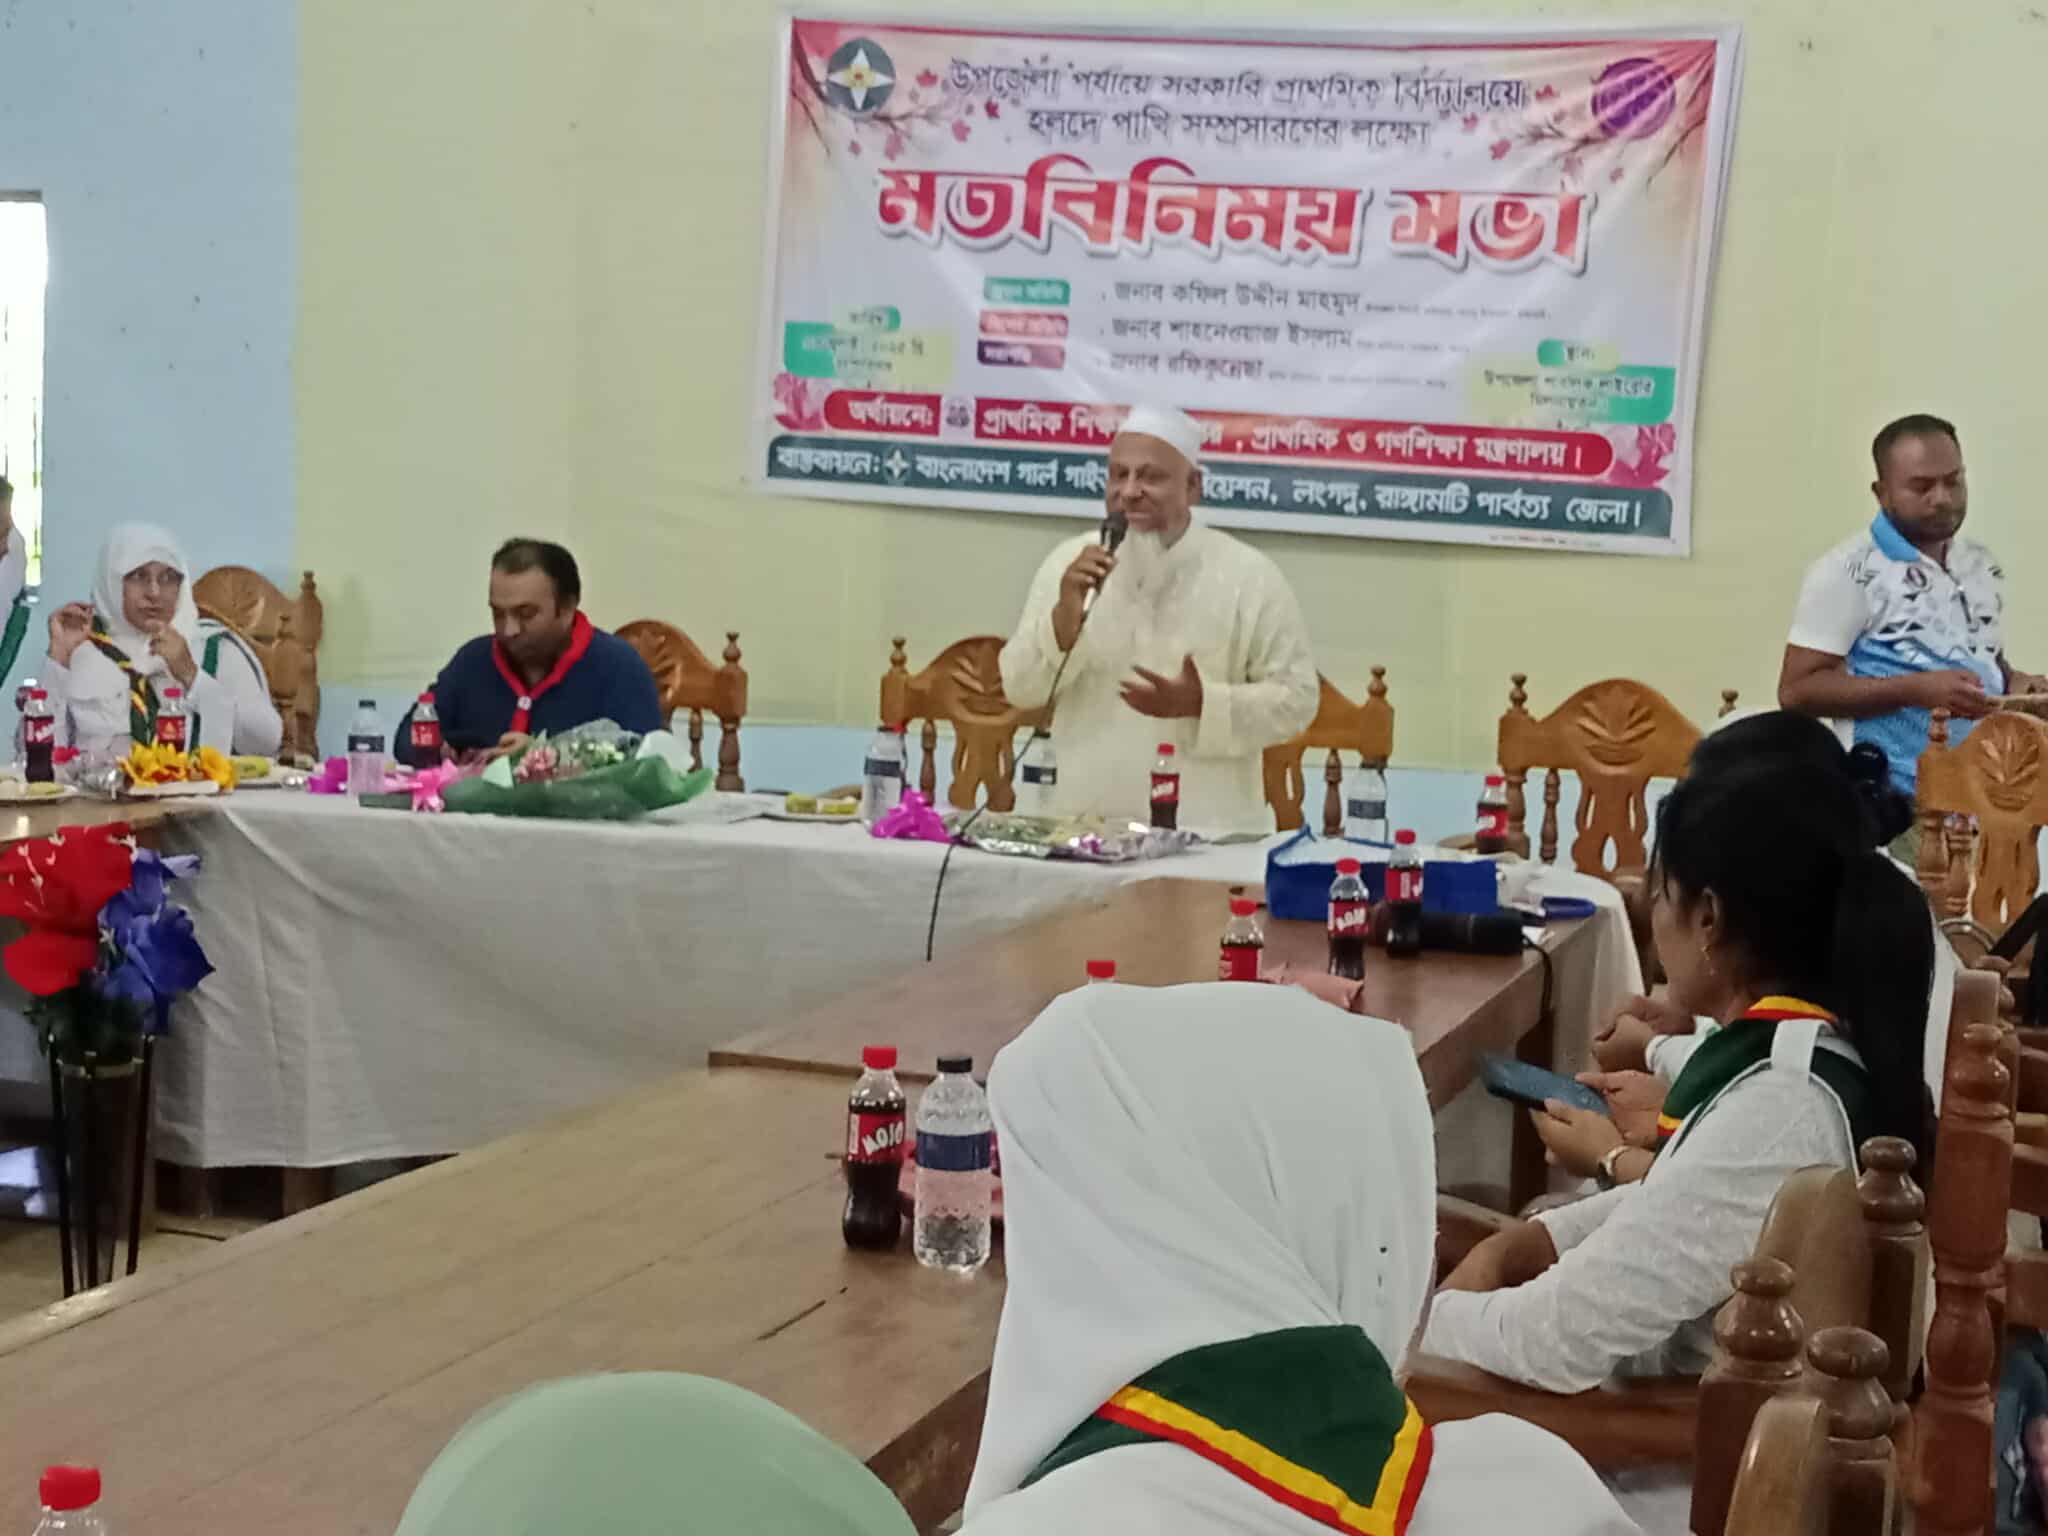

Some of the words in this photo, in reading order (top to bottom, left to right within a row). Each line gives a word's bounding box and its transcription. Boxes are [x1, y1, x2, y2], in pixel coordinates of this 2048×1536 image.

[950, 57, 1060, 98] উপজেলা
[1071, 64, 1150, 97] পর্যায়ে
[1160, 70, 1261, 99] সরকারি
[1275, 72, 1385, 104] প্রাথমিক
[1394, 74, 1525, 110] বিদ্যালয়ে
[1028, 107, 1099, 138] হলদে
[1111, 107, 1170, 140] পাখি
[1180, 112, 1338, 147] সম্প্রসারণের
[876, 152, 1366, 262] মতবিনিময়
[1388, 186, 1592, 270] সভা
[982, 402, 1064, 436] প্রাথমিক
[1251, 420, 1339, 453] প্রাথমিক
[1346, 431, 1367, 454] ও
[1375, 425, 1467, 463] গণশিক্ষা
[915, 452, 1013, 486] বাংলাদেশ
[1476, 488, 1553, 521] পার্বত্য
